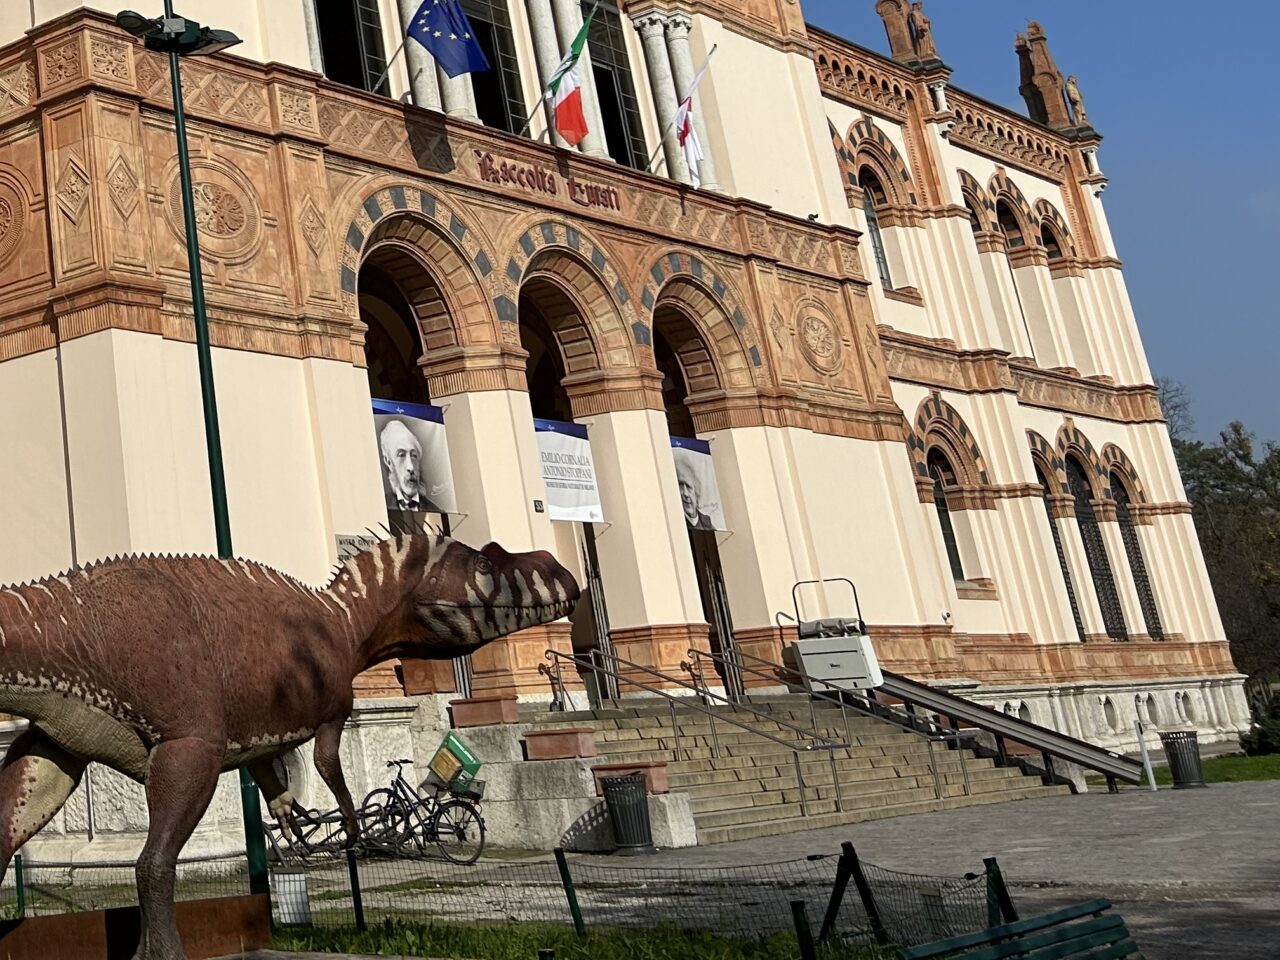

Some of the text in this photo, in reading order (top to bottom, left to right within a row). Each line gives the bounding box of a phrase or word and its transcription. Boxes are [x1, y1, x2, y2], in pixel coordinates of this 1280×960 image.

[474, 150, 557, 195] Raccolta
[541, 451, 560, 464] EMILIO
[543, 465, 567, 477] ANTONIO
